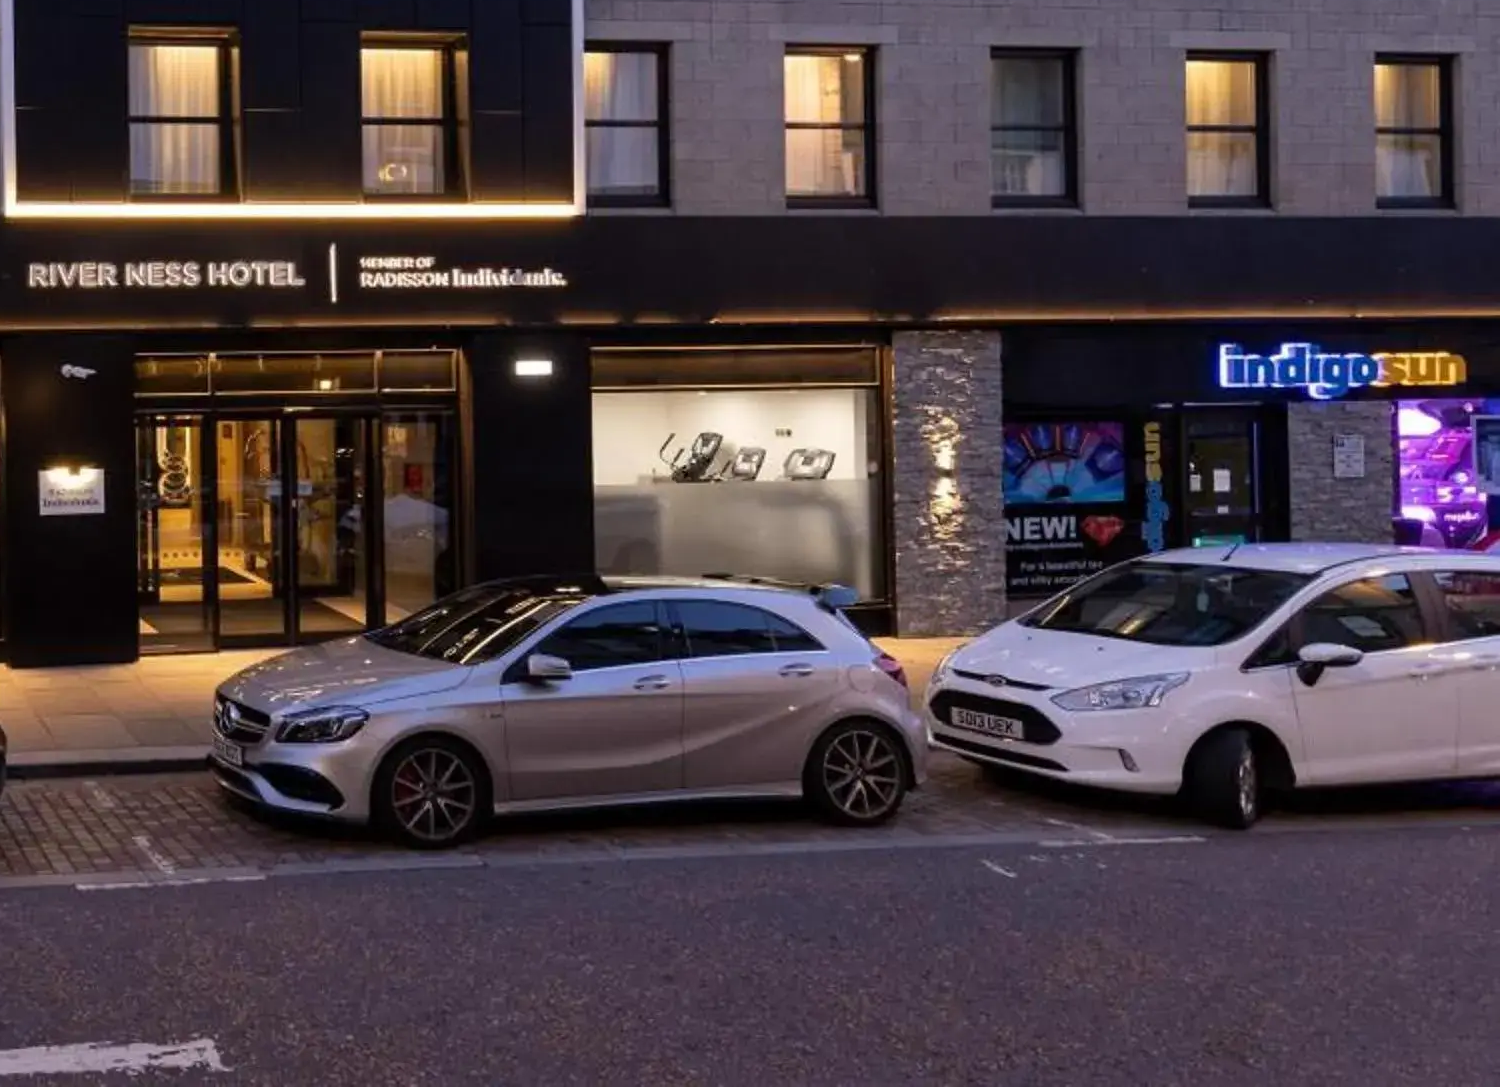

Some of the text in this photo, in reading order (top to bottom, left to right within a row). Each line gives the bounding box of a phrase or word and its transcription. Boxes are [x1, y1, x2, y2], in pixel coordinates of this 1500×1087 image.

[28, 261, 306, 288] RIVER NESS HOTEL
[359, 257, 435, 268] MEMBER OF
[360, 272, 449, 287] RADISSON
[1219, 342, 1467, 400] indigosun
[1005, 516, 1077, 541] NEW!
